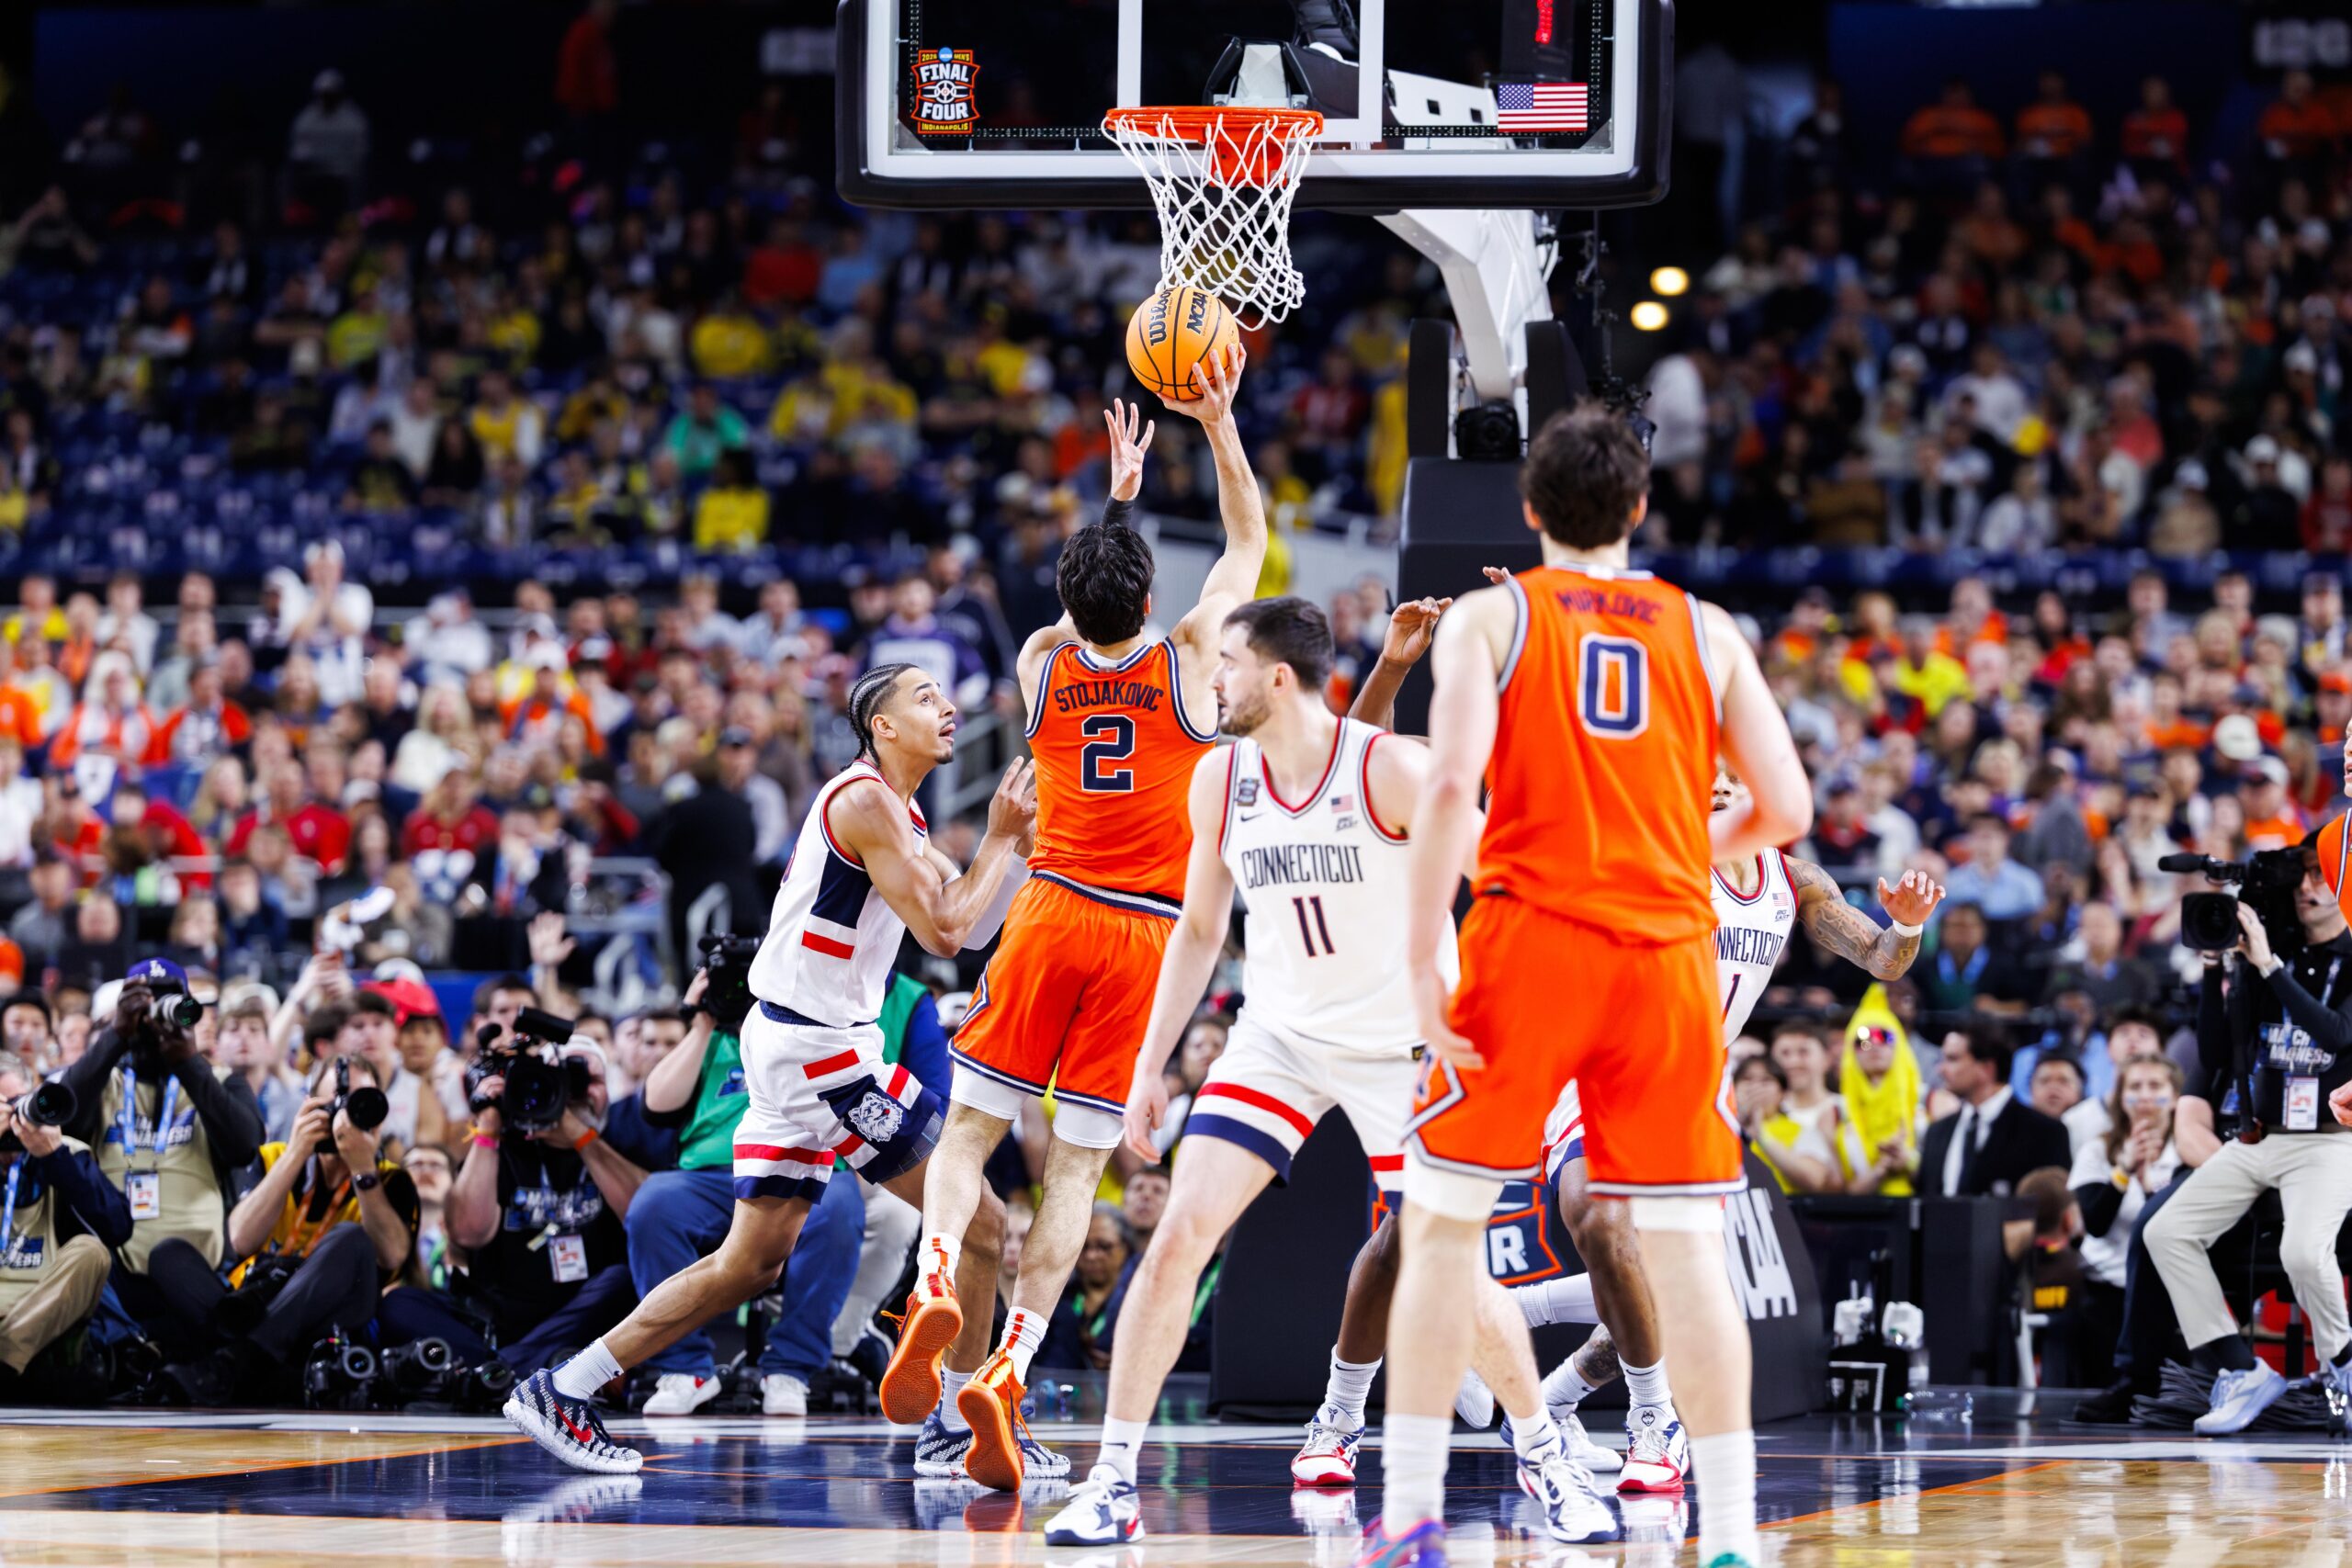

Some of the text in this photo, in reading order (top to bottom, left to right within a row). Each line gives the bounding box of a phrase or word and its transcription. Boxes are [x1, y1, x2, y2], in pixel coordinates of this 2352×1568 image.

[920, 63, 968, 83] FINAL
[921, 101, 969, 120] FOUR
[1186, 291, 1208, 334] NCAA
[1055, 681, 1164, 712] STOJAKOVIC
[1577, 632, 1649, 740] 0
[1081, 715, 1136, 792] 2
[1241, 844, 1364, 888] CONNECTICUT
[1292, 895, 1336, 957] 11
[1712, 926, 1783, 966] NNECTICUT
[2267, 1027, 2311, 1047] MACH
